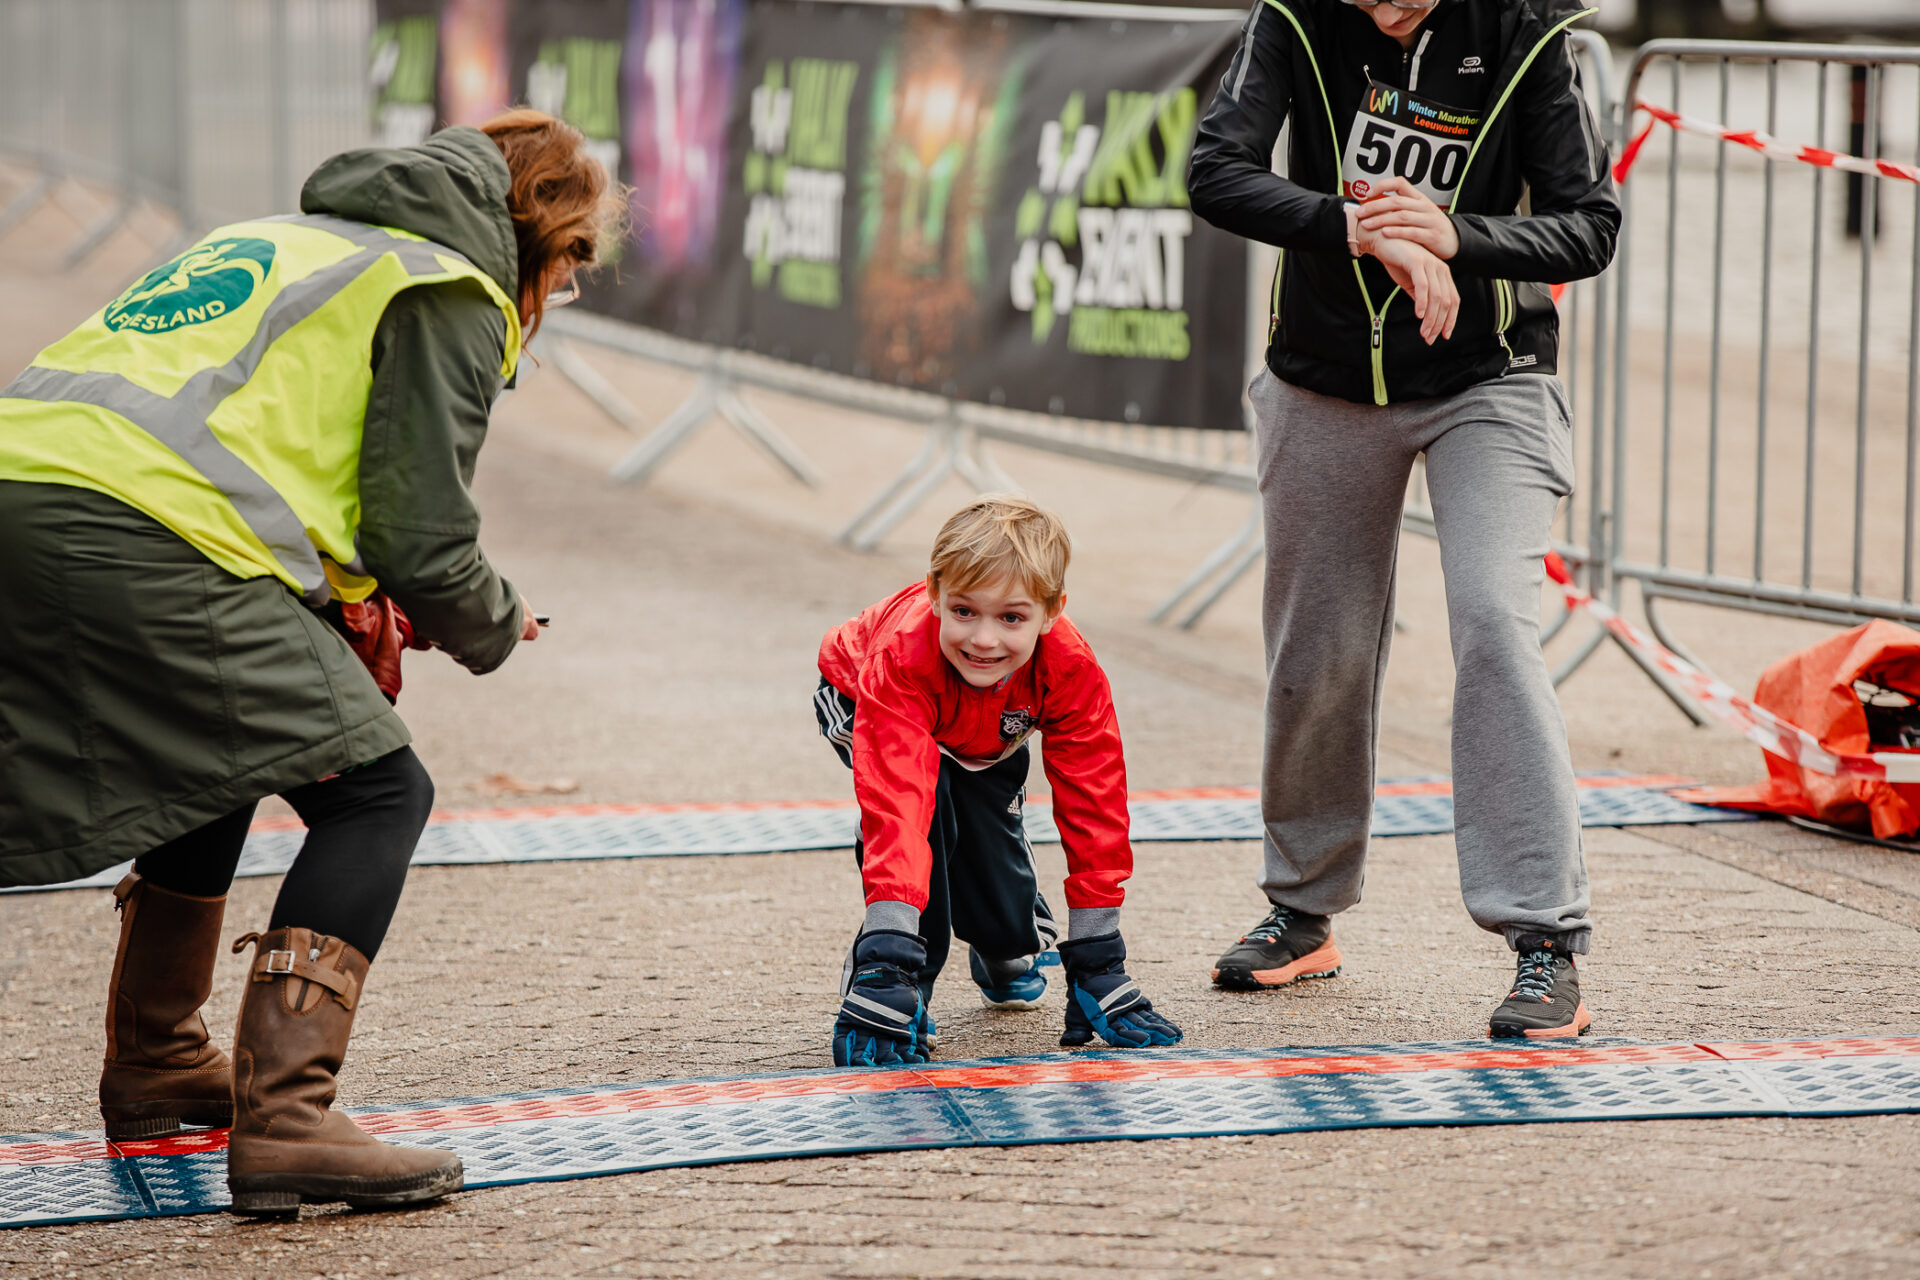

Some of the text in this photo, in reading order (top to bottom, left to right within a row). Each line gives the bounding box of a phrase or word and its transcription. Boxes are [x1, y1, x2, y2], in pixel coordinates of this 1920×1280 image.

[1407, 99, 1437, 118] Winter
[1413, 114, 1469, 135] Leeuwarden
[1356, 120, 1469, 191] 500
